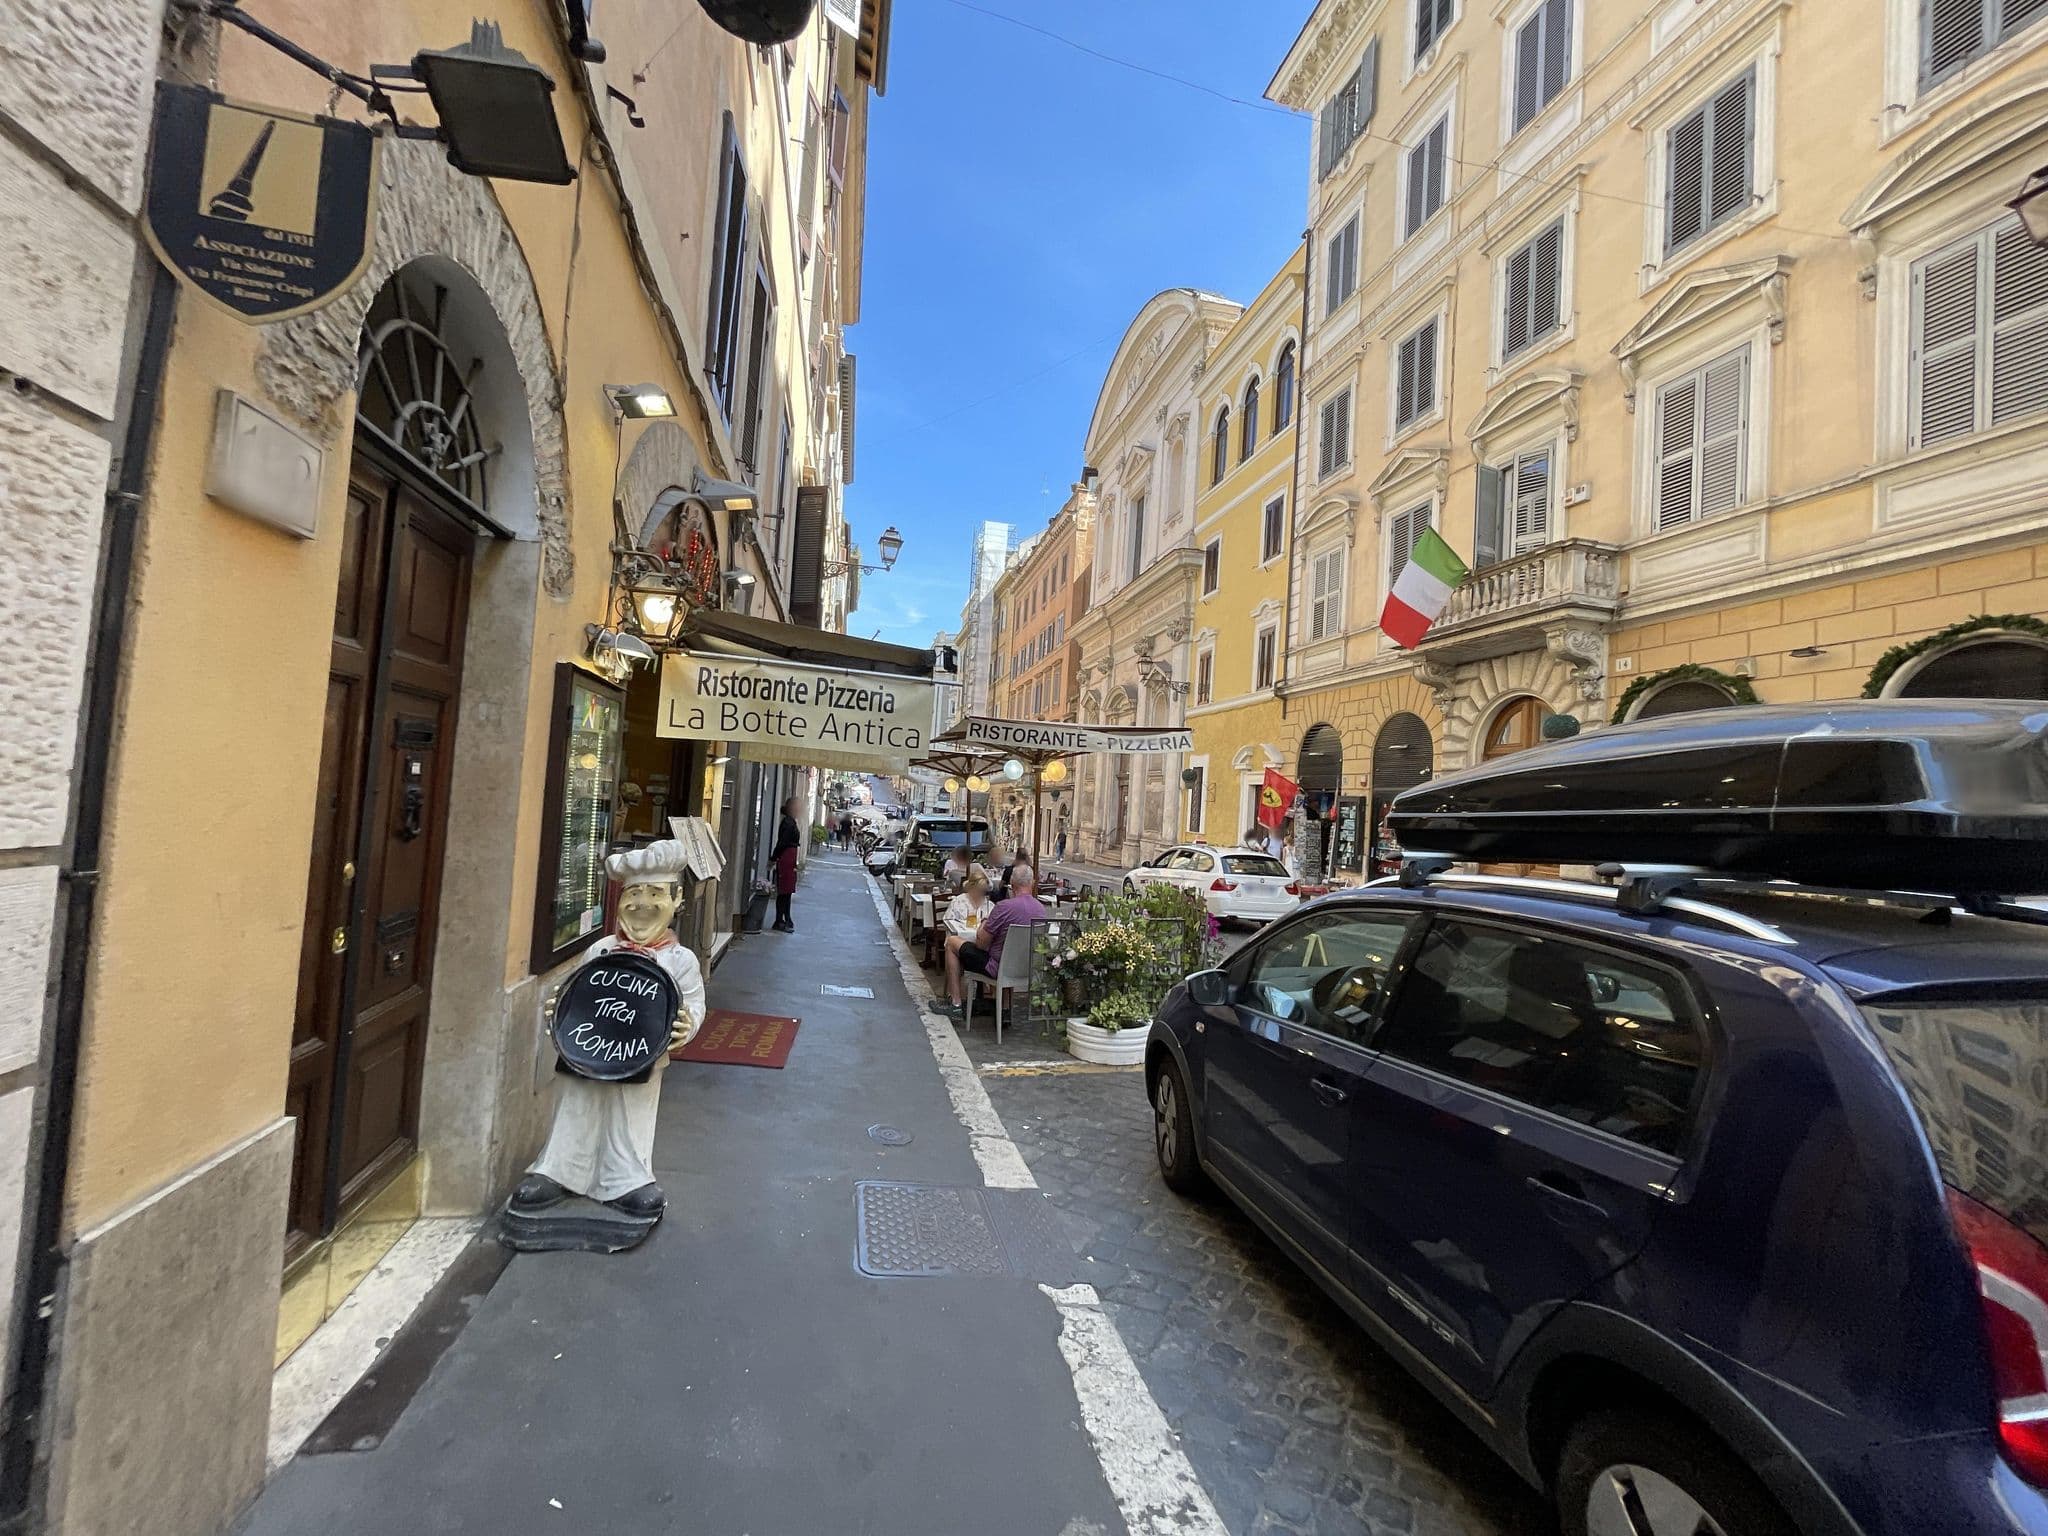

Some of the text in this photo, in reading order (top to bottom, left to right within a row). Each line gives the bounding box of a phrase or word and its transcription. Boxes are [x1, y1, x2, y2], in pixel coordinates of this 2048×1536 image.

[697, 666, 895, 714] Ristorante Pizzeria
[668, 699, 920, 749] La Botte Antica
[969, 722, 1087, 748] RISTORANTE
[1107, 734, 1191, 751] PIZZERIA
[589, 970, 659, 1001] CUCINA
[567, 1022, 649, 1063] ROMANA
[701, 1018, 737, 1050] CUCINA
[728, 1023, 758, 1048] TIPICA
[751, 1021, 785, 1058] ROMANA
